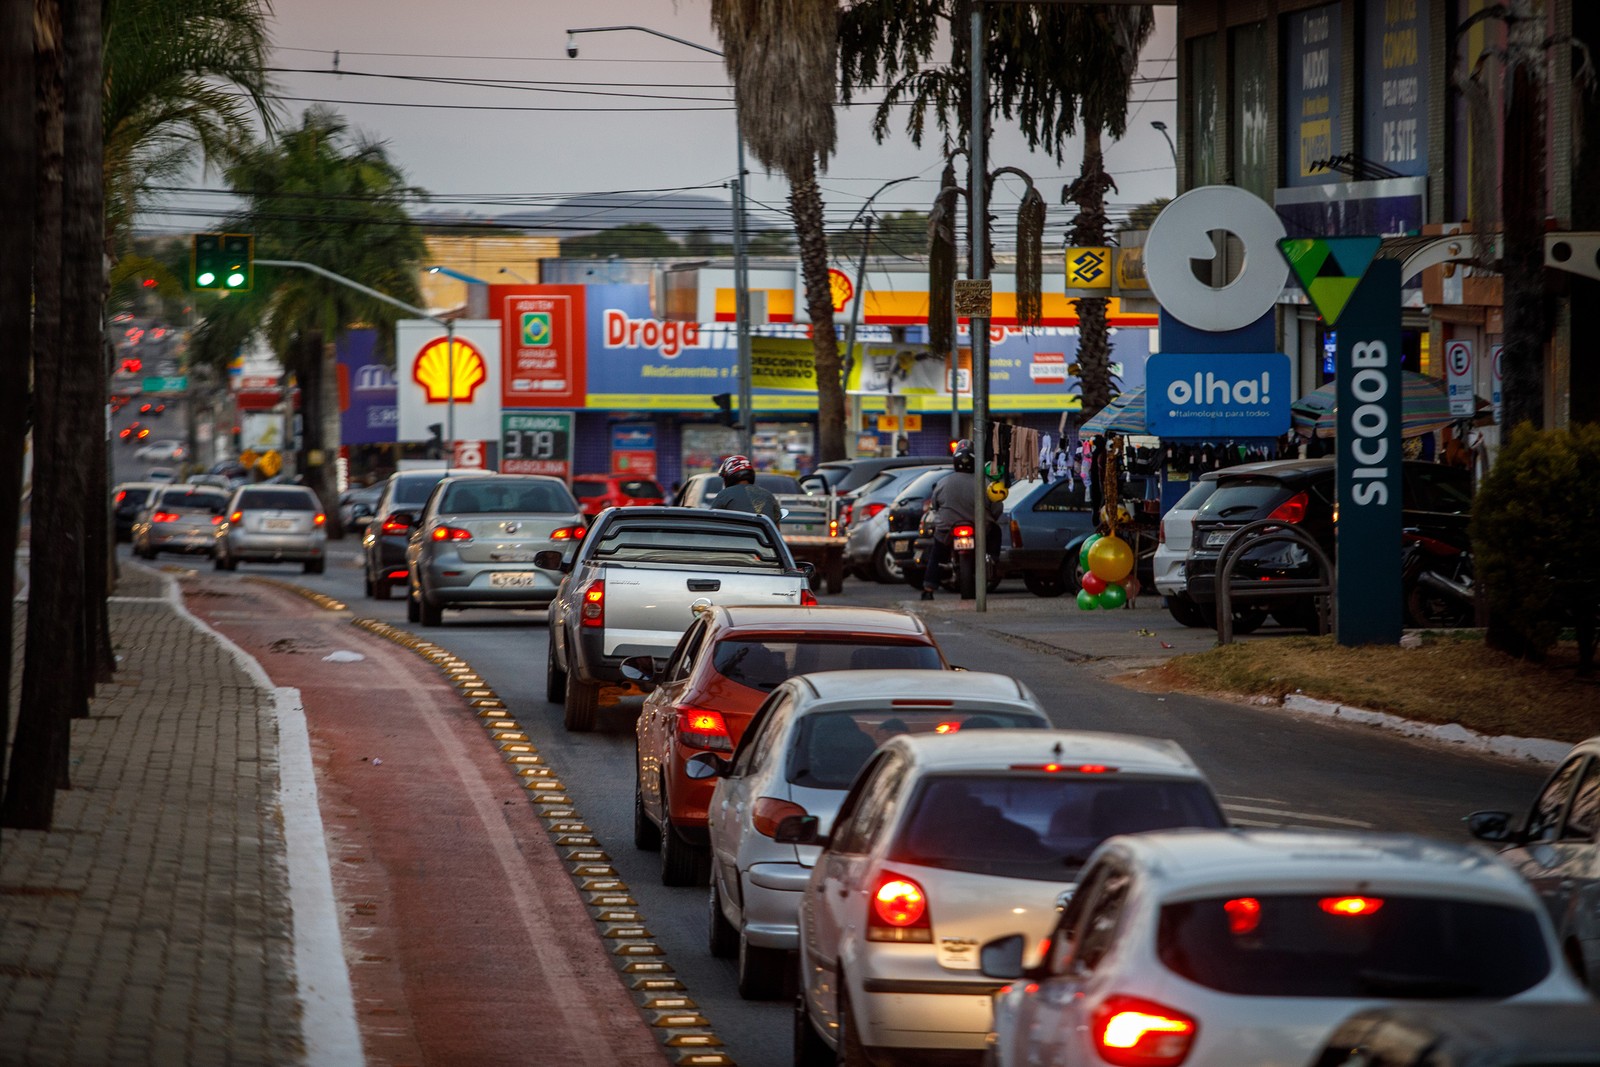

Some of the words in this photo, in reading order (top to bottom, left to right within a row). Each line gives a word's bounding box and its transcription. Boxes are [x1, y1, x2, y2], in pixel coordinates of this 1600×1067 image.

[1397, 119, 1417, 162] SITE
[1455, 350, 1463, 369] E
[1167, 372, 1270, 405] olha!
[508, 417, 563, 431] ETANOL
[1351, 340, 1389, 506] SICOOB
